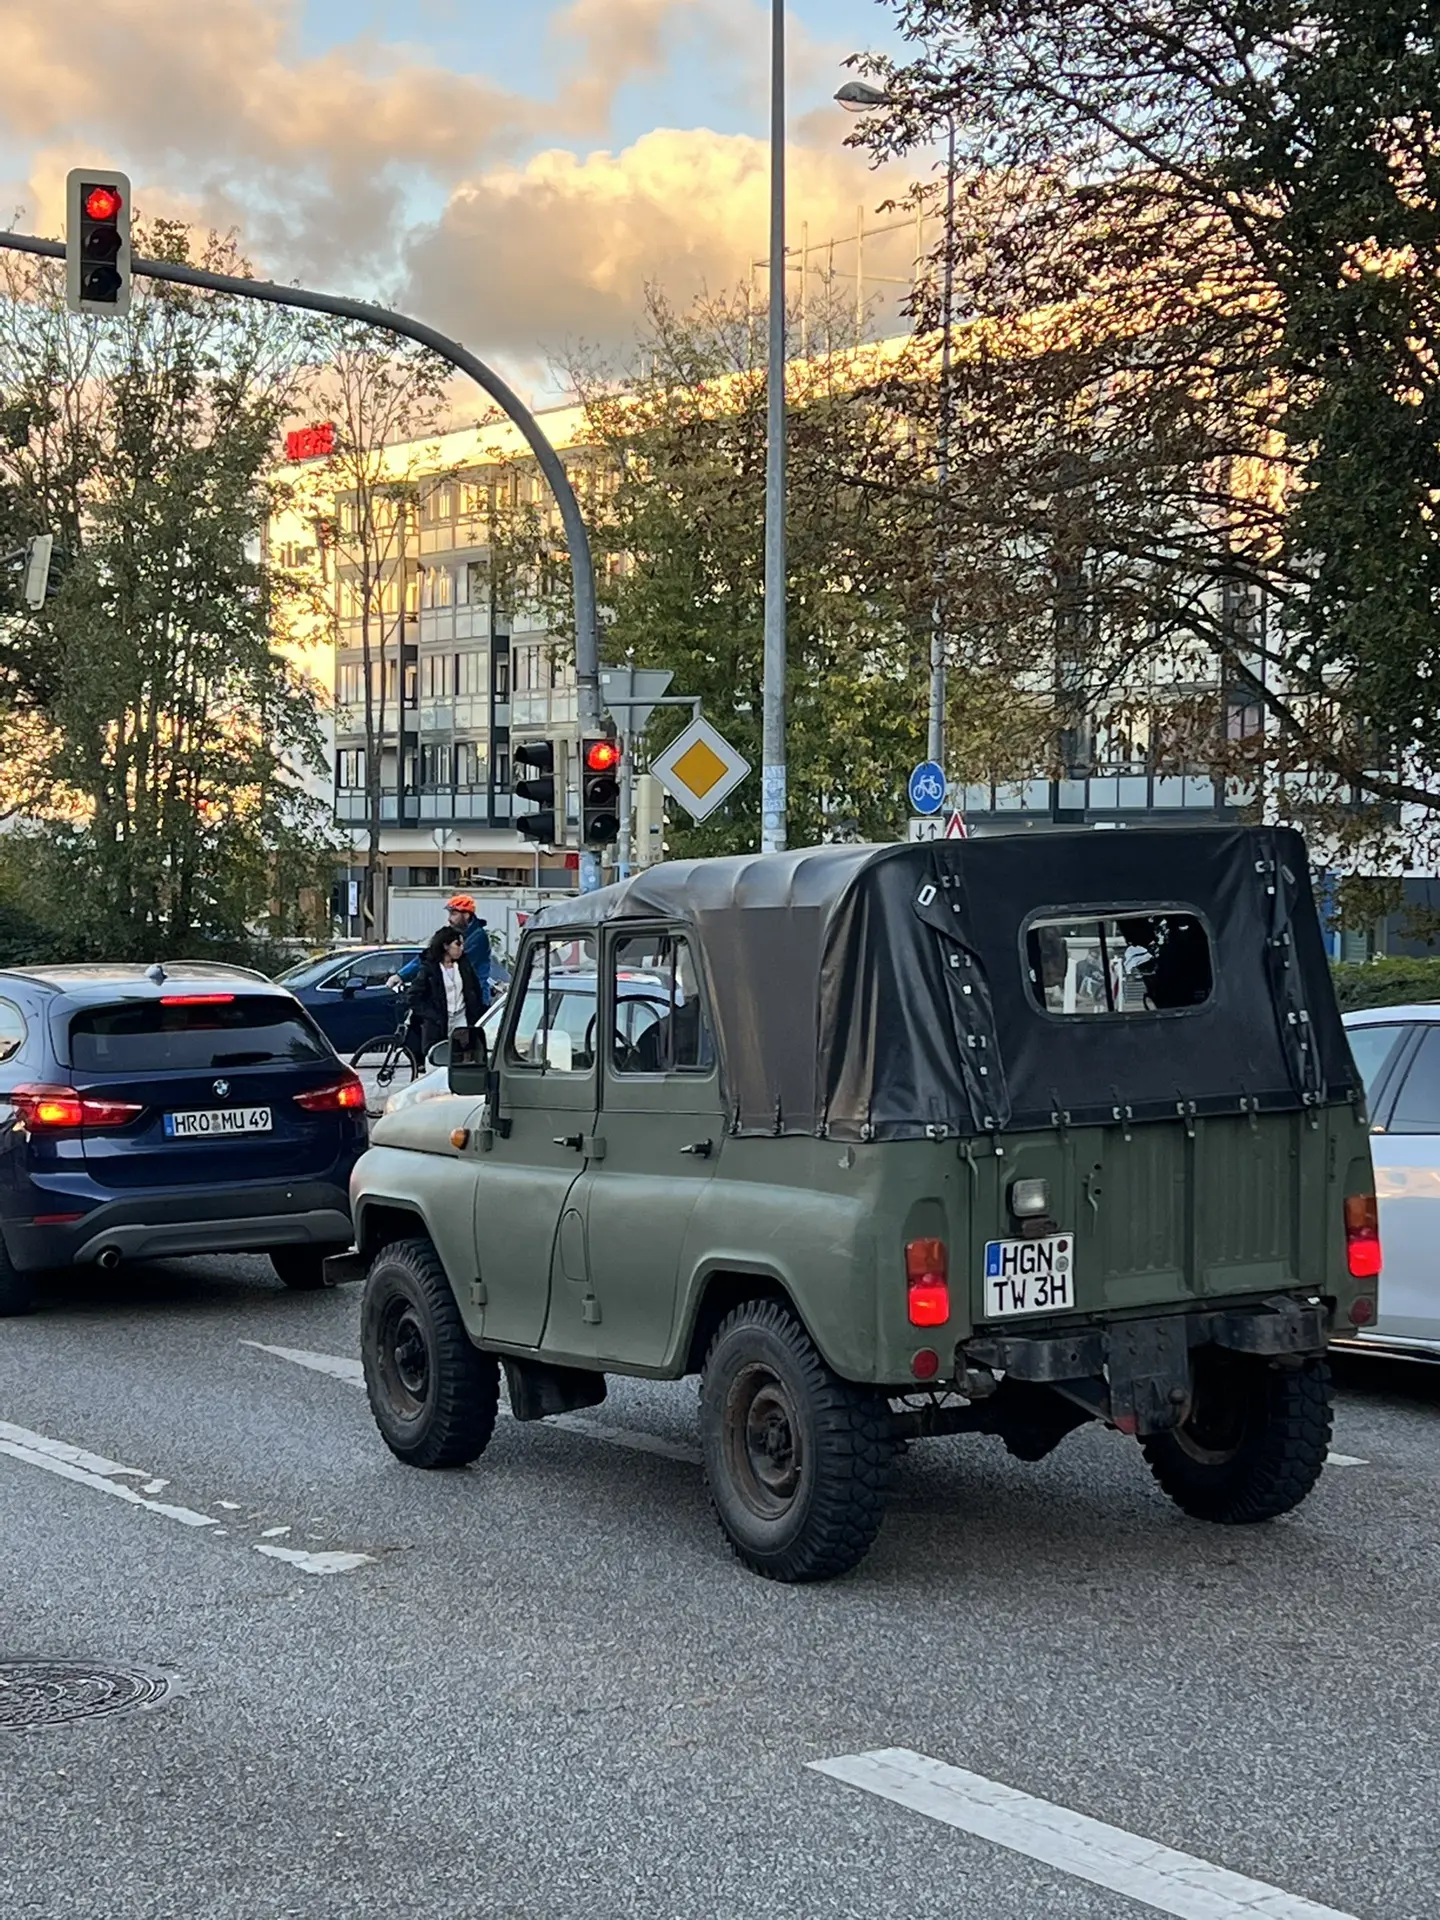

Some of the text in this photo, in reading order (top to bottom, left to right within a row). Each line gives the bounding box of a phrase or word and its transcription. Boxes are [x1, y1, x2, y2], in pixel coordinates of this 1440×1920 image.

[174, 1110, 269, 1133] HRO MU 49
[1002, 1242, 1053, 1276] HGN
[993, 1274, 1067, 1311] TW 3H
